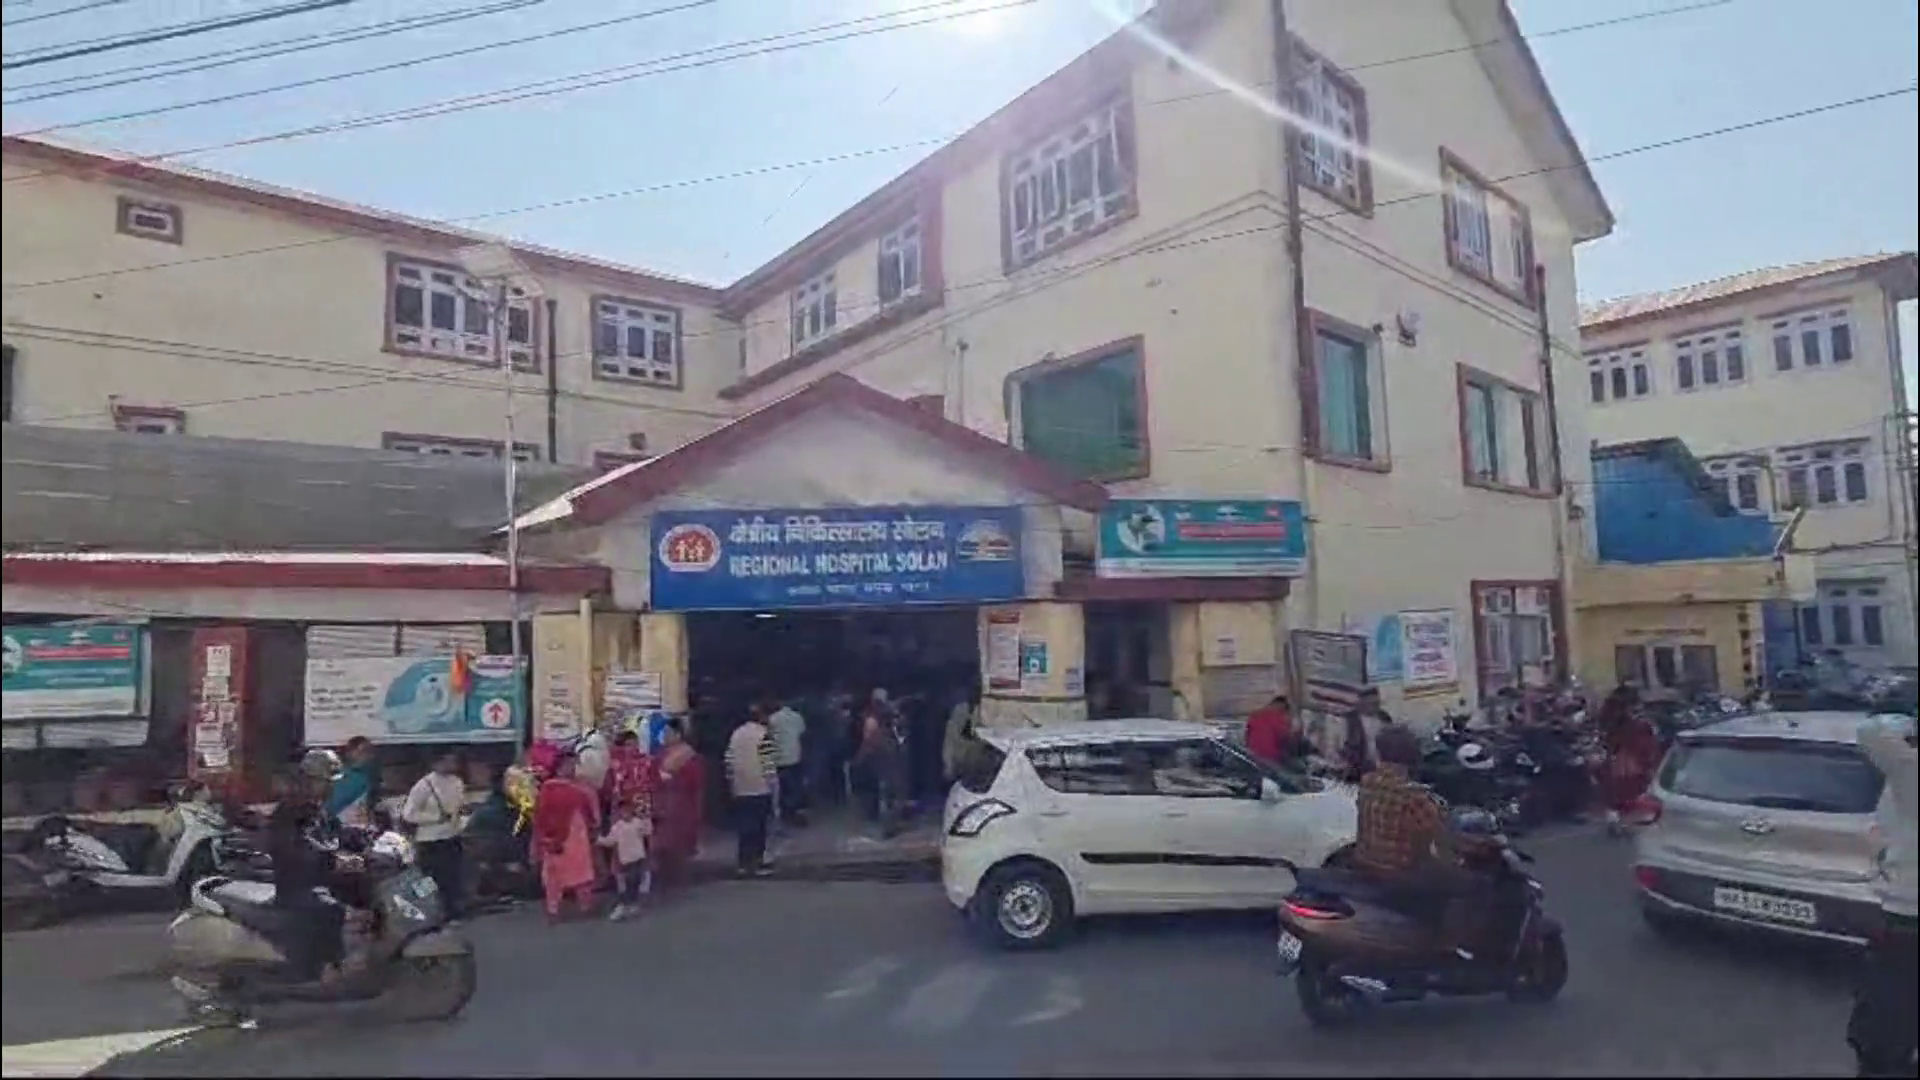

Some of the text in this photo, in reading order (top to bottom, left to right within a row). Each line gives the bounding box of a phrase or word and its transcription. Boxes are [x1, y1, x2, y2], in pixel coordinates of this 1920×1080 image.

[729, 550, 949, 577] REGIONAL HOSPITAL SOLAN
